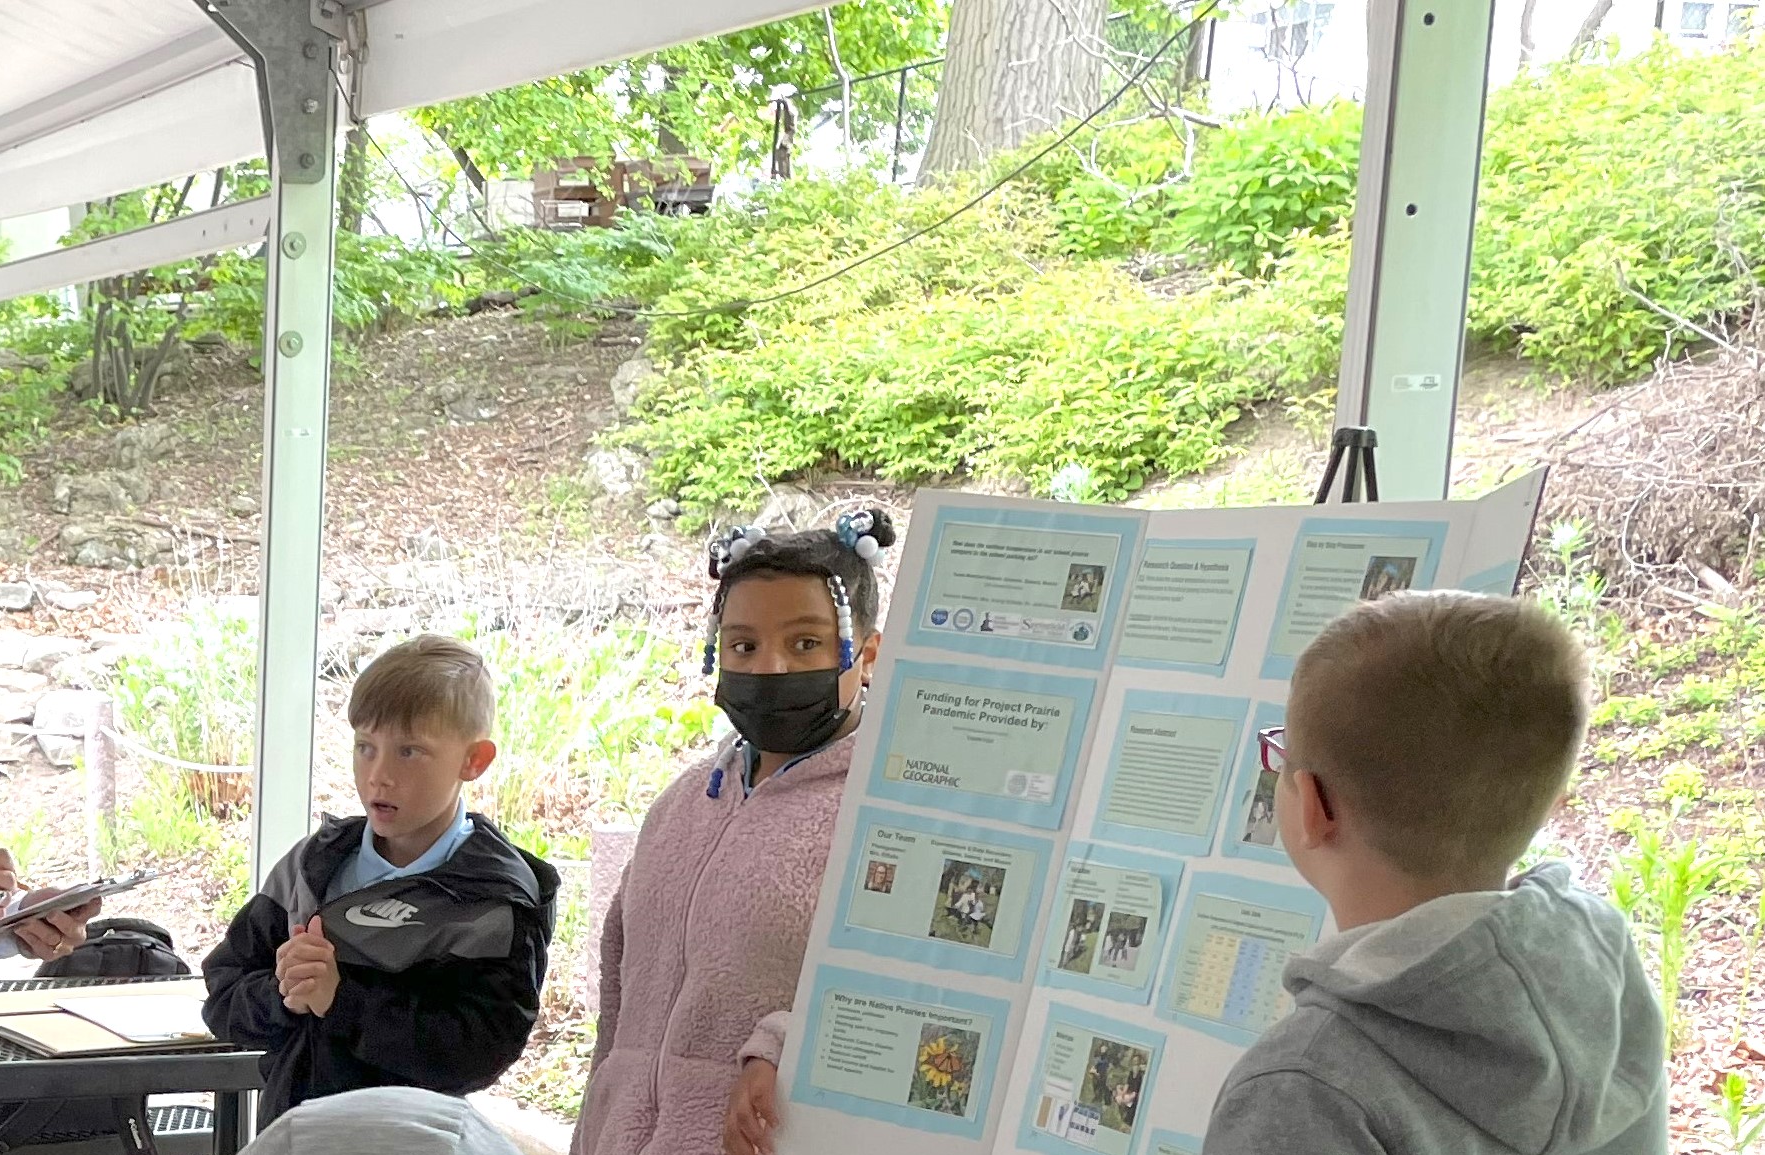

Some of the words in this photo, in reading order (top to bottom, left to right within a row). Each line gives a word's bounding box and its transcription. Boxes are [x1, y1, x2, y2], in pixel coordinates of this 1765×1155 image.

[916, 689, 962, 707] Funding
[964, 695, 980, 707] for
[982, 698, 1021, 714] Project
[1024, 703, 1060, 717] Prairie
[922, 704, 976, 721] Pandemic
[978, 711, 1028, 727] Provided
[906, 759, 950, 775] NATIONAL
[902, 769, 961, 788] GEOGRAPHIC
[877, 829, 892, 840] Our
[894, 832, 916, 843] Team
[361, 899, 419, 921] NIKE
[834, 993, 852, 1005] Why
